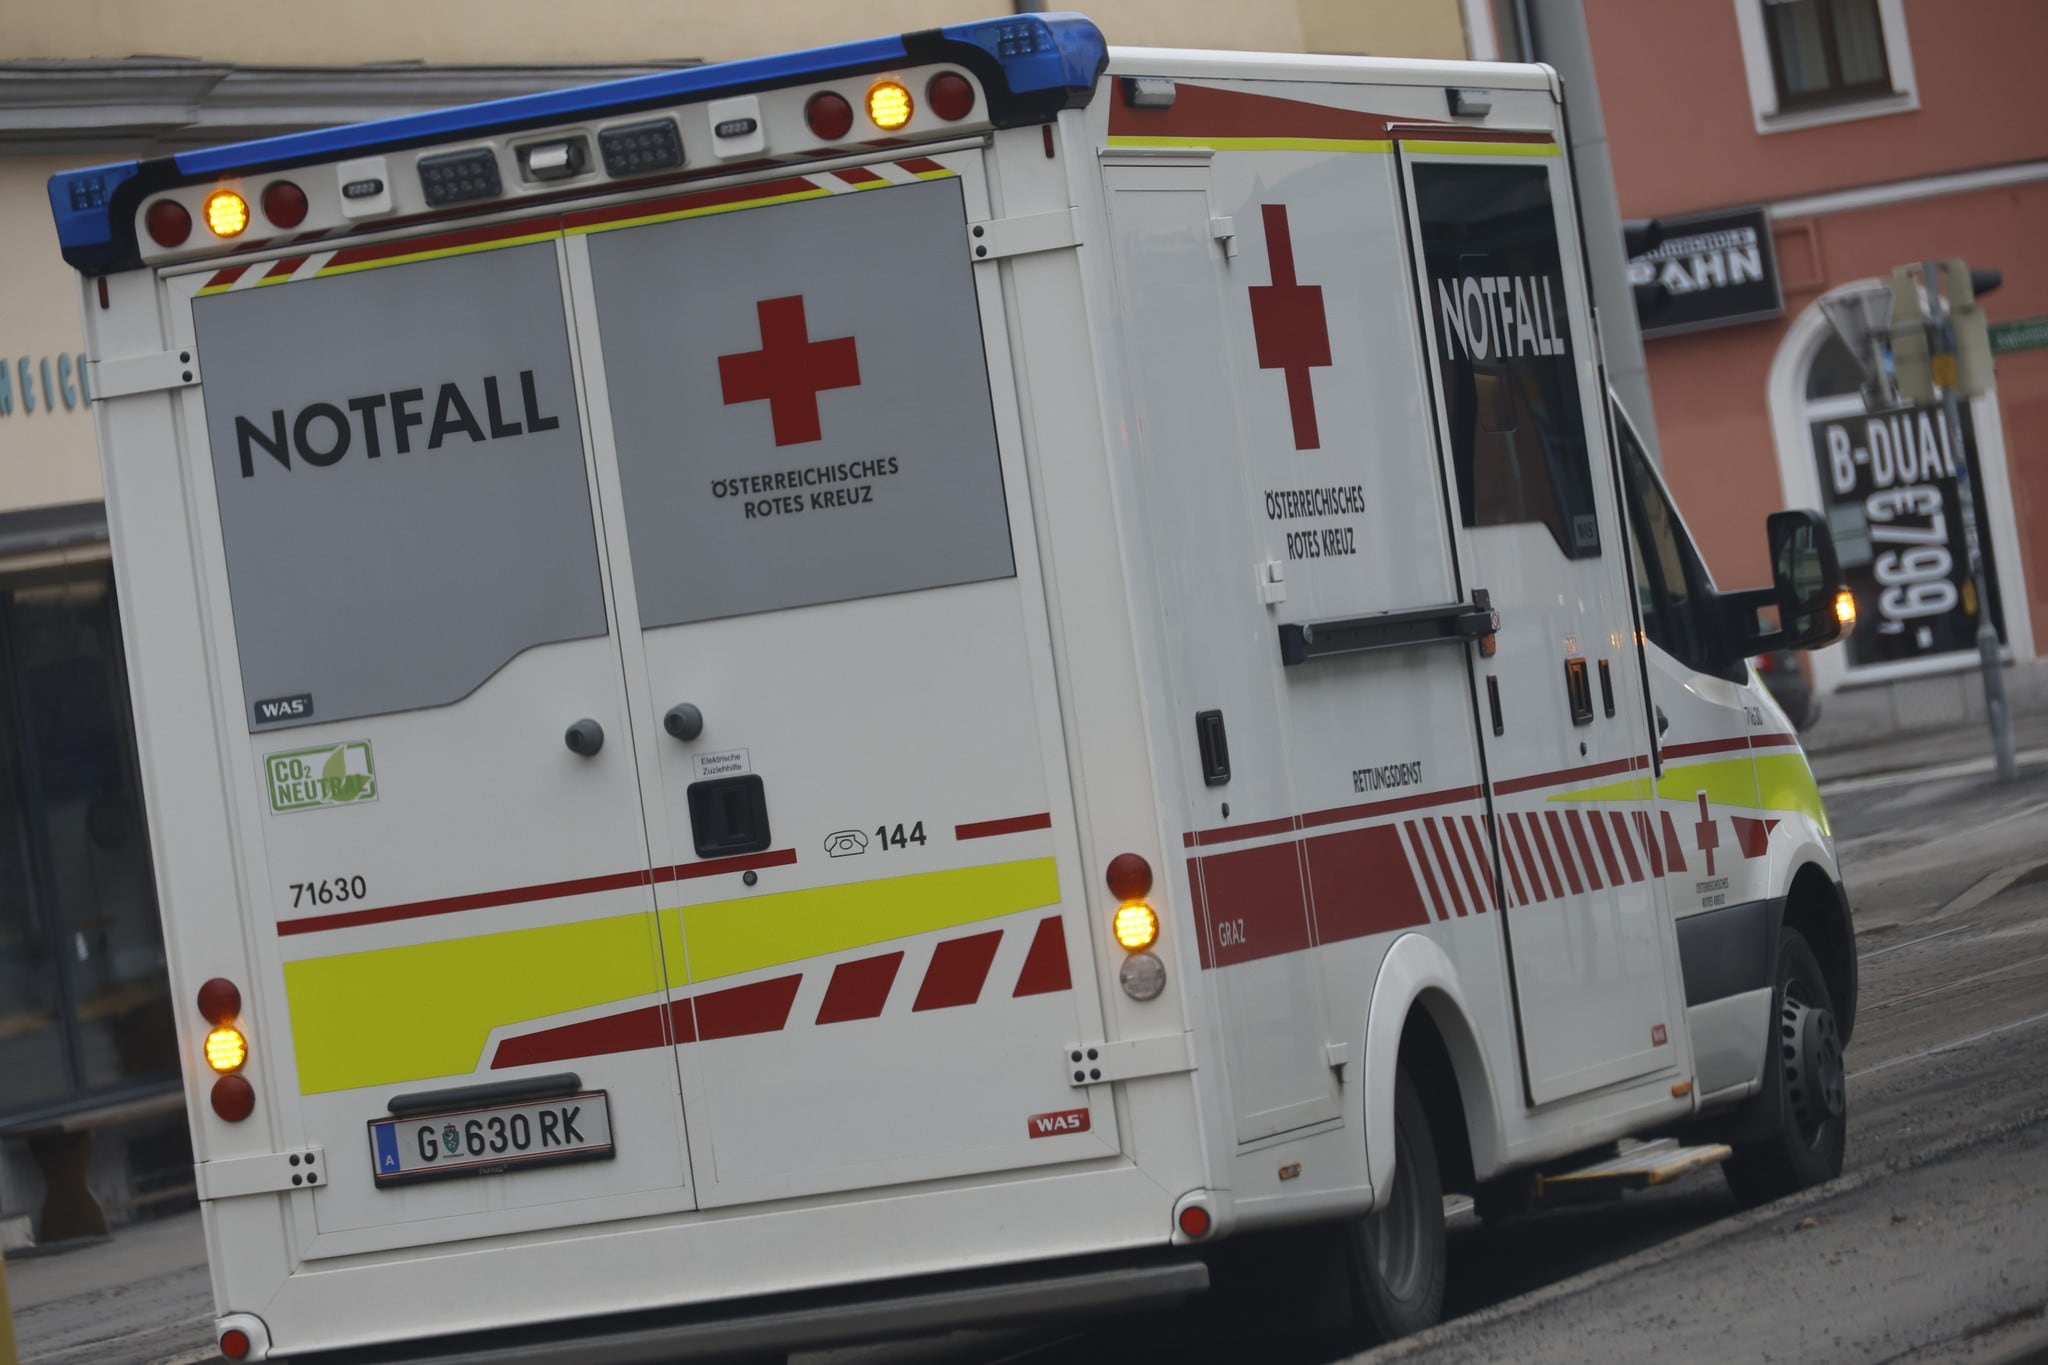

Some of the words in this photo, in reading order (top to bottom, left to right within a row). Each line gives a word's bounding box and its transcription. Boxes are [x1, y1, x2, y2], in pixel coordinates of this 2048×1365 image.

[1437, 275, 1566, 361] NOTFALL
[234, 369, 560, 479] NOTFALL
[711, 456, 899, 499] ÖSTERREICHISCHES
[743, 494, 805, 519] ROTES
[810, 485, 873, 510] KREUZ
[1264, 485, 1365, 520] ÖSTERREICHISCHES
[1286, 530, 1321, 560] ROTES
[1321, 527, 1356, 557] KREUZ
[262, 698, 305, 718] WAS
[700, 753, 742, 766] Elektrische
[1352, 760, 1422, 793] RETTUNGSDIENST
[875, 820, 928, 851] 144
[289, 874, 367, 908] 71630
[1218, 918, 1246, 947] GRAZ
[385, 1155, 395, 1166] A
[417, 1125, 439, 1162] G
[464, 1113, 531, 1156] 630
[538, 1105, 584, 1147] RK
[1036, 1114, 1080, 1132] WAS
